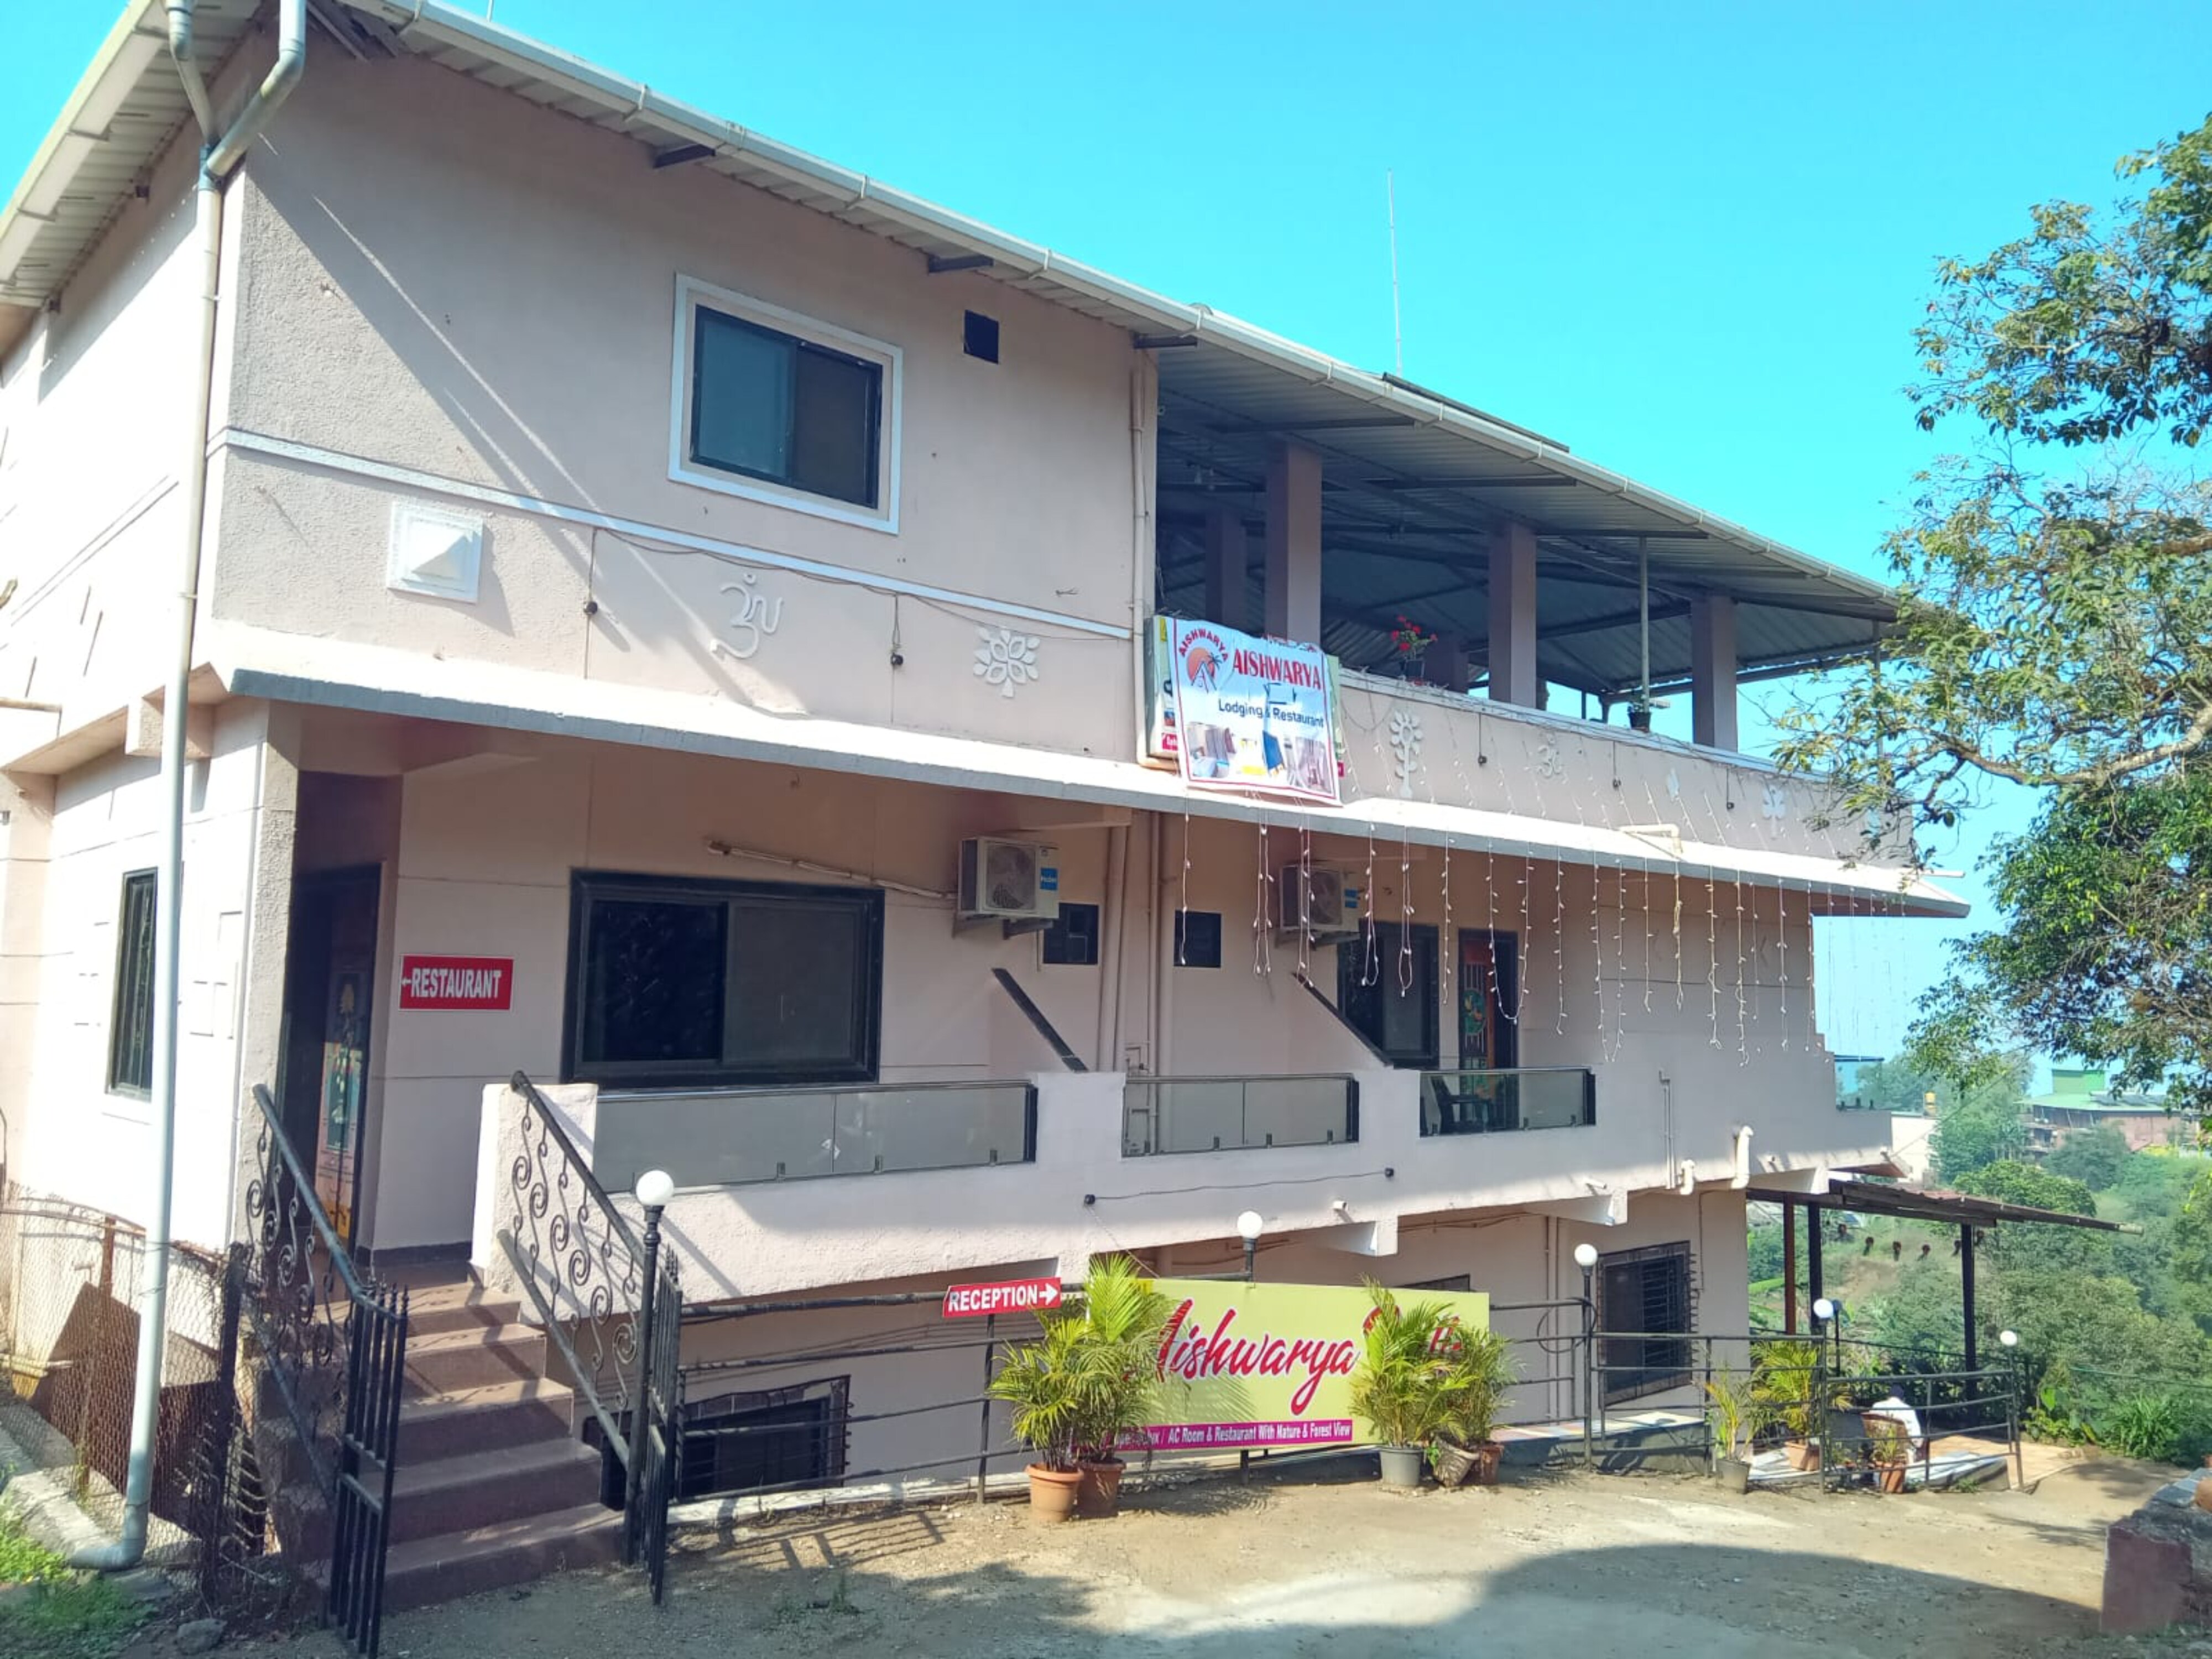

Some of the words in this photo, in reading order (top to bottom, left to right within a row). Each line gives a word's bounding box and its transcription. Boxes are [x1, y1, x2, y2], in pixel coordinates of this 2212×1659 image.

[1179, 628, 1229, 661] AISHWARYA
[1233, 648, 1322, 691] AISHWARYA
[1218, 698, 1262, 718] Lodging
[1273, 707, 1324, 728] Restaurant
[410, 968, 502, 999] RESTAURANT
[948, 1285, 1038, 1312] RECEPTION
[1168, 1428, 1180, 1444] AC
[1182, 1427, 1205, 1443] Room
[1215, 1425, 1256, 1441] Restaurant
[1258, 1424, 1275, 1440] With
[1310, 1421, 1332, 1438] Forest
[1333, 1421, 1350, 1437] View
